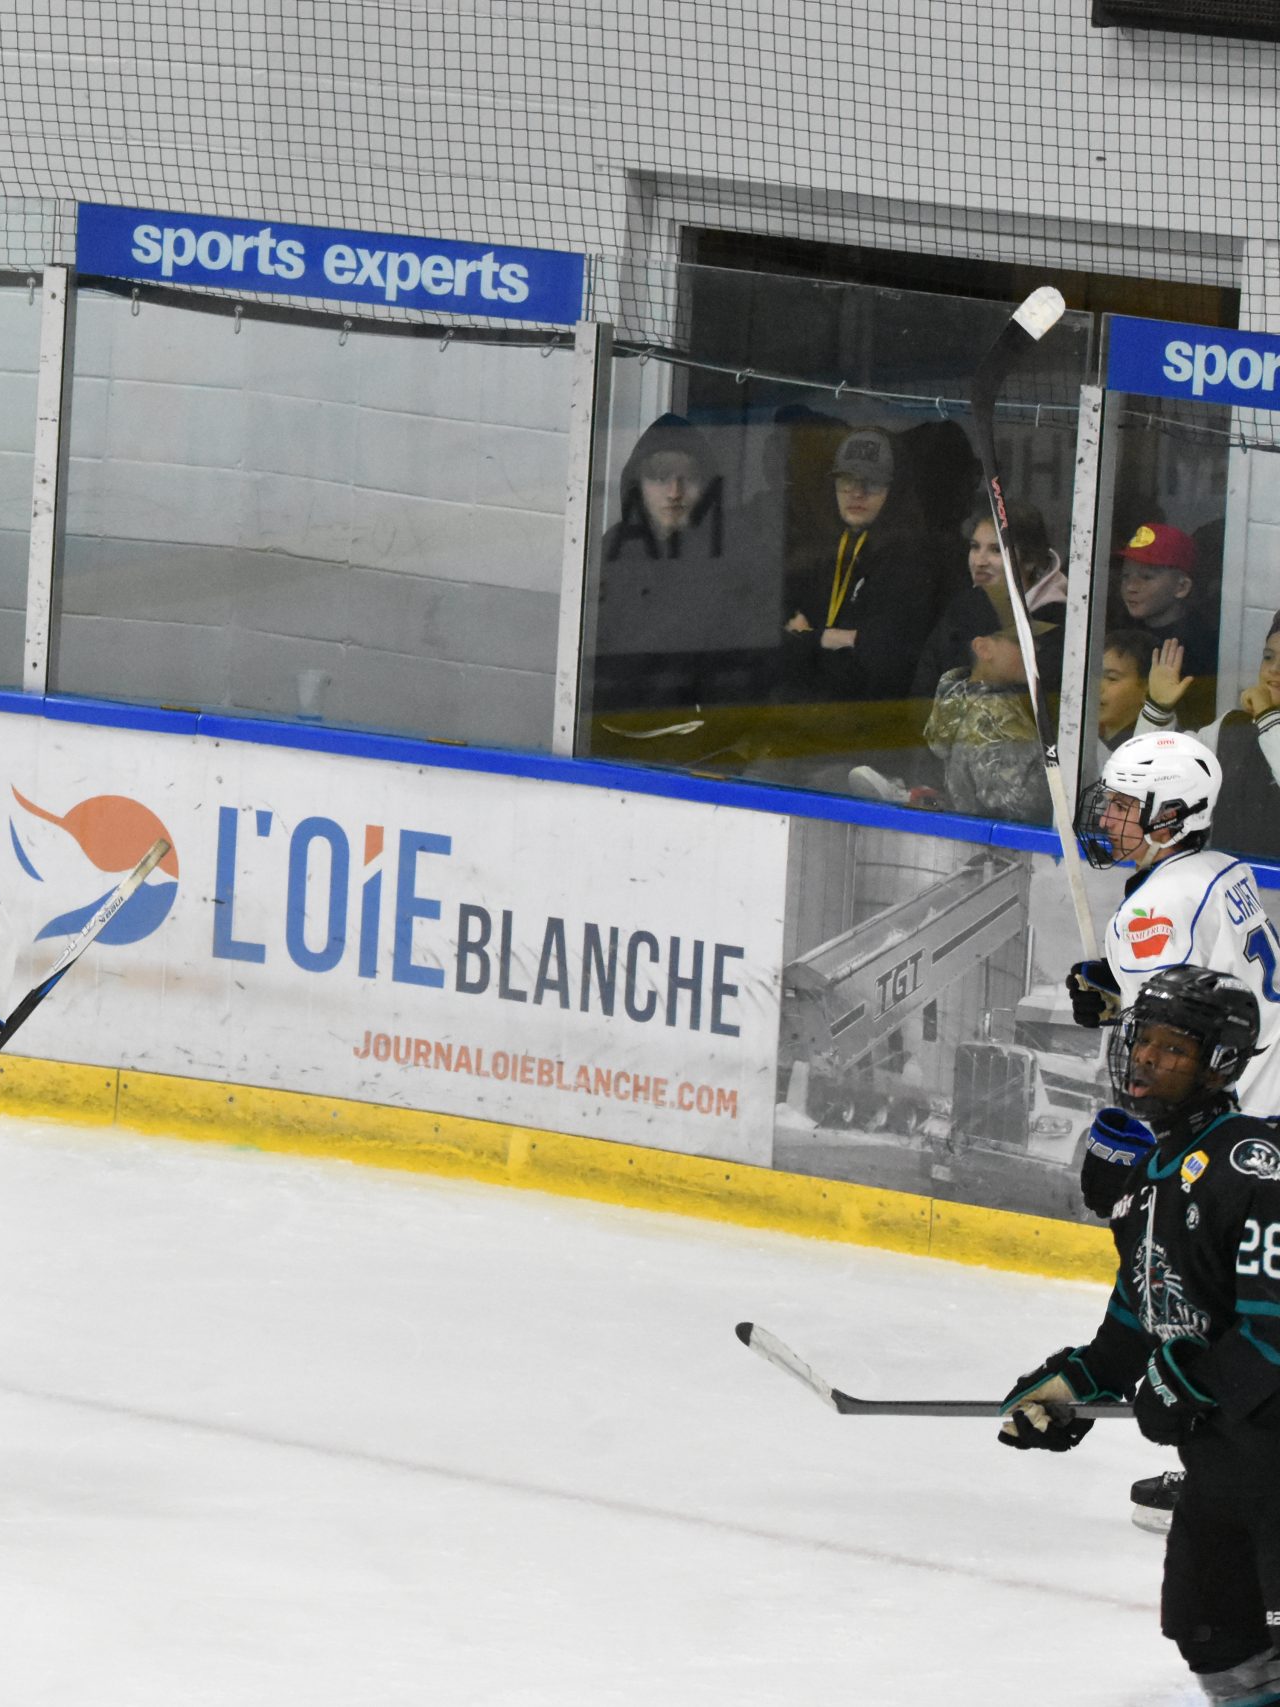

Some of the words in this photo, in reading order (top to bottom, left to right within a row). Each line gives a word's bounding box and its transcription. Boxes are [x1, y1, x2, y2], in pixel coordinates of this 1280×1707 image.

[131, 223, 305, 280] sports
[323, 243, 530, 303] experts
[1162, 340, 1280, 396] spor
[455, 903, 745, 1037] BLANCHE
[876, 949, 924, 1011] TGT
[352, 1029, 740, 1120] JOURNALOIEBLANCHE.COM
[1235, 1218, 1280, 1281] 28
